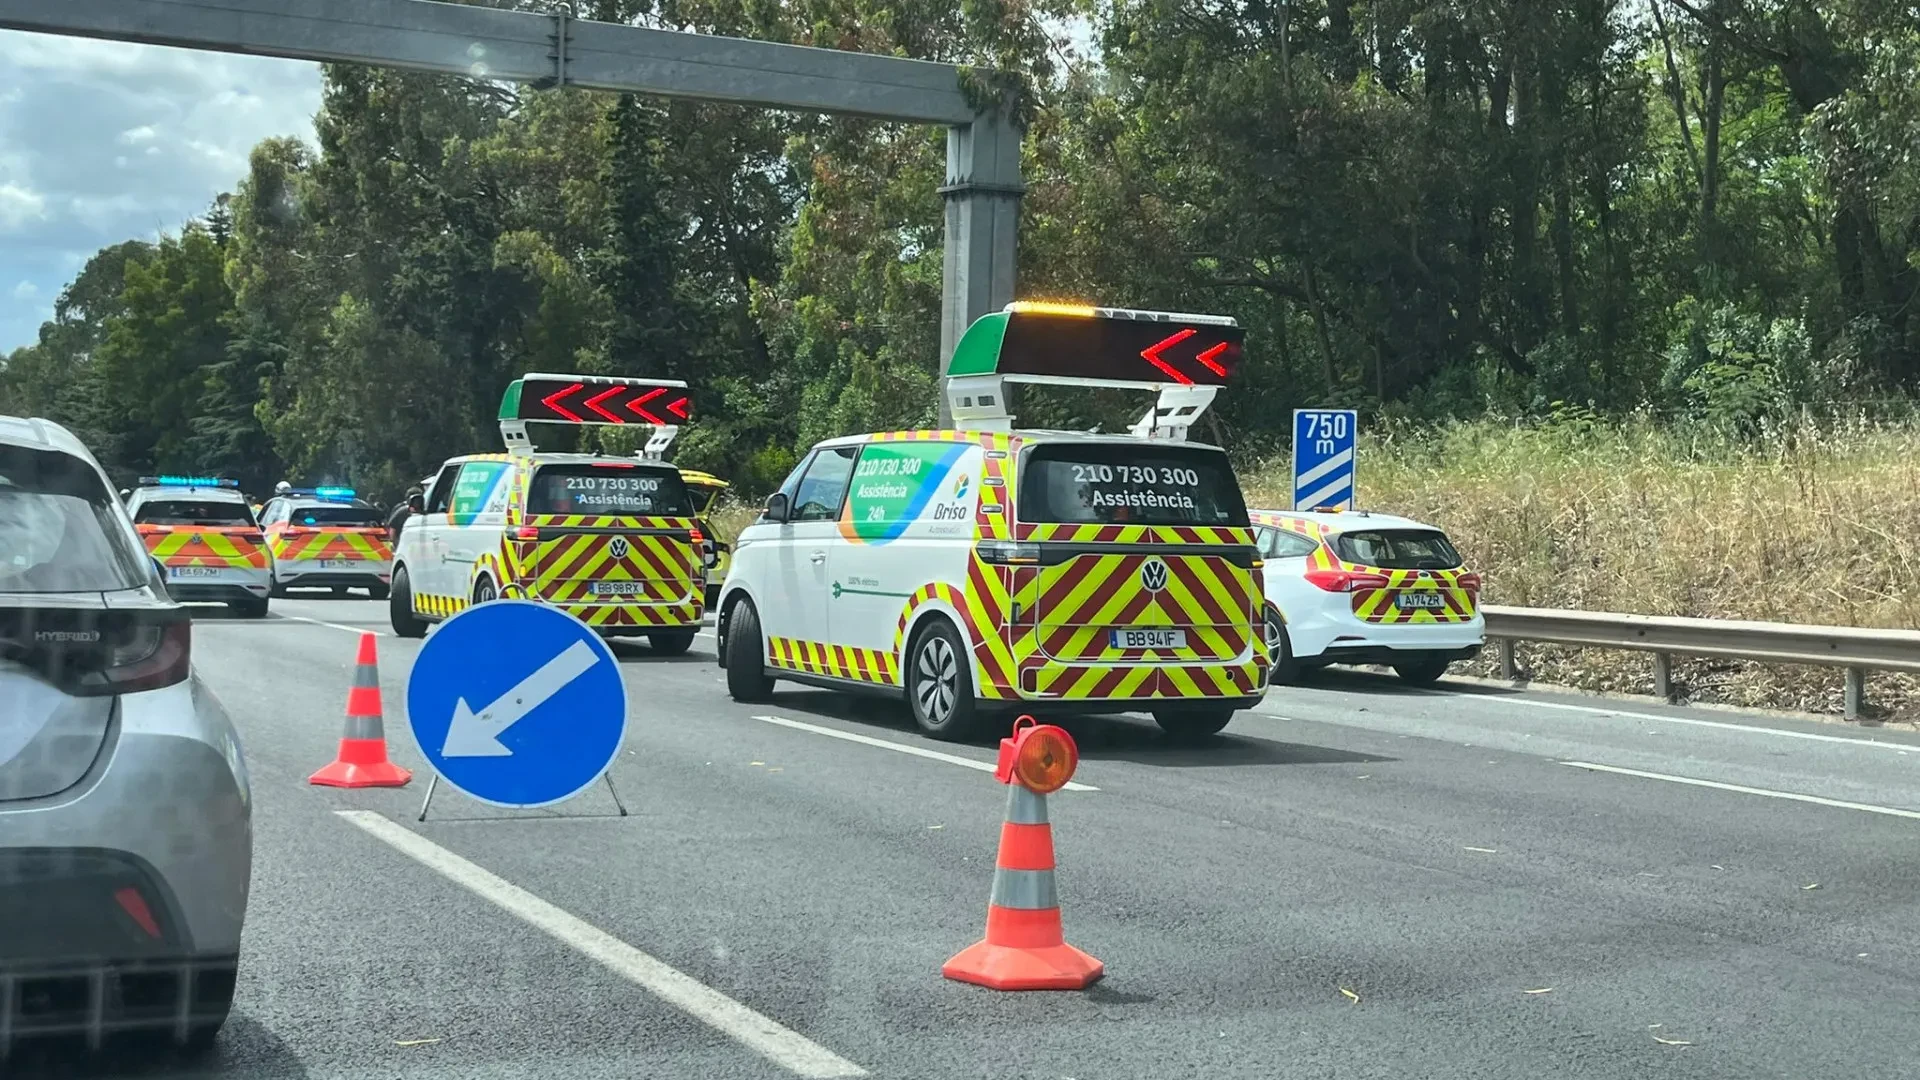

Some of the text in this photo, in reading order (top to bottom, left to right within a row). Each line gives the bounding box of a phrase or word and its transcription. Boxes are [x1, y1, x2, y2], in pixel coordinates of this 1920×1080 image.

[1304, 413, 1347, 439] 750
[1315, 439, 1335, 454] m
[857, 457, 921, 476] 210 730 300
[1071, 465, 1199, 487] 210 730 300
[566, 478, 658, 491] 210 730 300
[857, 481, 908, 498] Assistência
[578, 493, 652, 506] Assistência
[1092, 490, 1194, 509] Assistência
[866, 505, 886, 521] 24h
[35, 631, 90, 641] HYBRID
